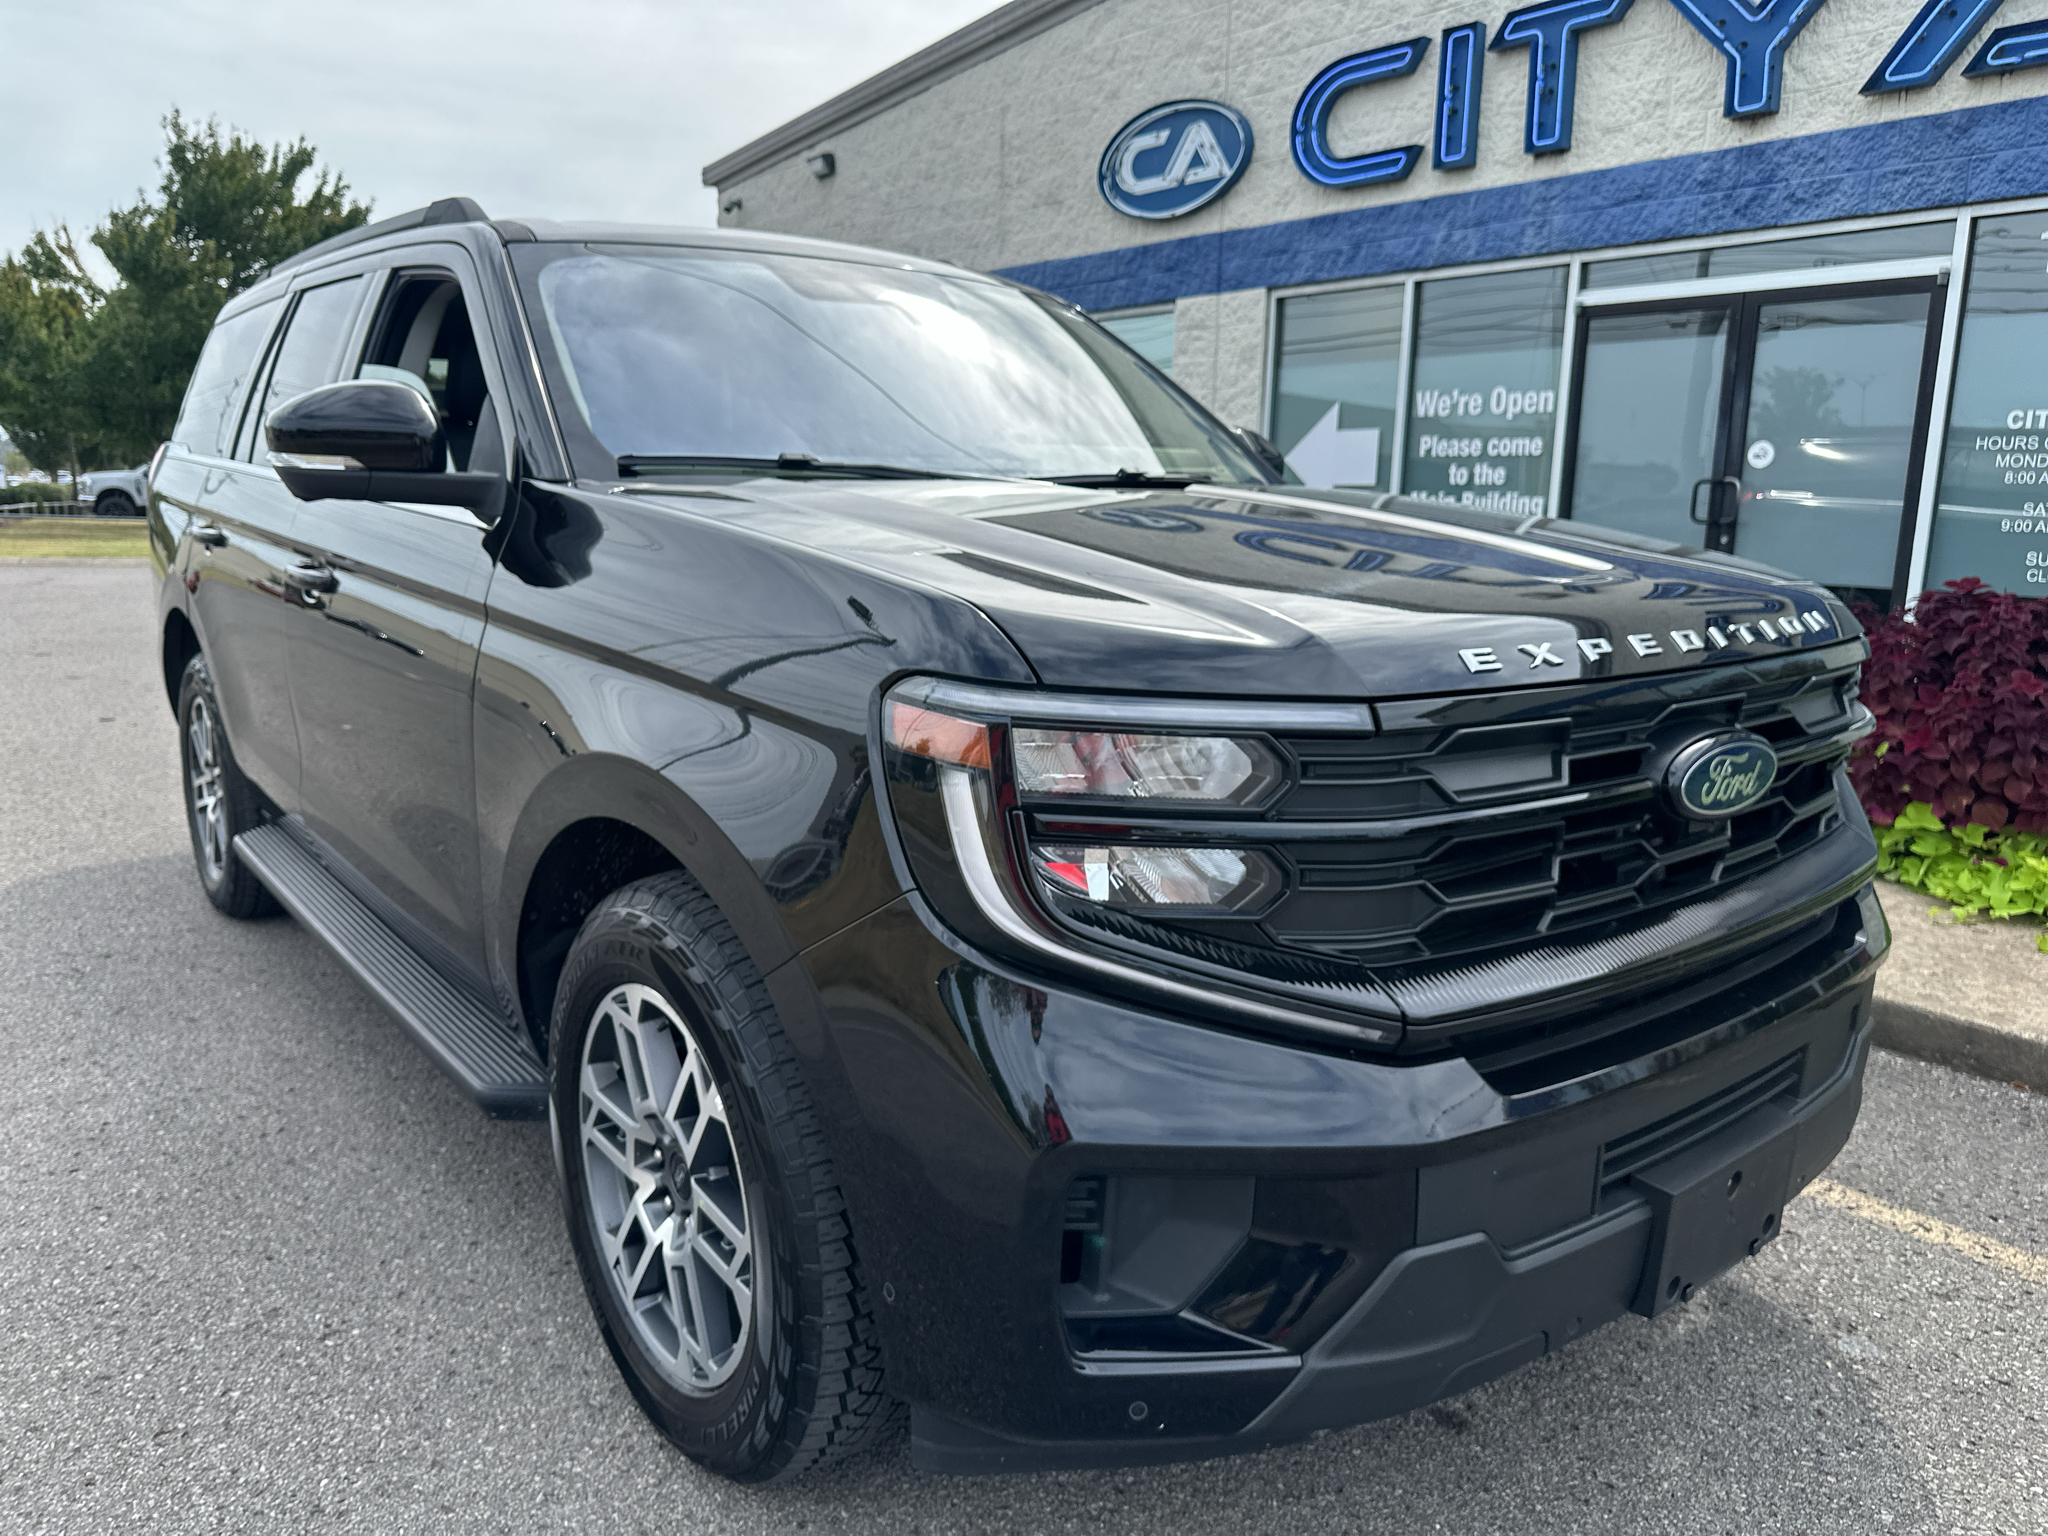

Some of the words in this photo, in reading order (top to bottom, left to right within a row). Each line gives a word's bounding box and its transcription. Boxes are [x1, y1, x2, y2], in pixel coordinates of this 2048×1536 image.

[1290, 0, 1822, 188] CITY
[1115, 119, 1232, 196] CA
[1416, 388, 1483, 418] We're
[1489, 385, 1555, 420] Open
[1419, 434, 1483, 458] Please
[1487, 435, 1543, 457] come
[1976, 435, 2039, 451] HOURS
[1995, 453, 2048, 468] MOND
[1448, 462, 1469, 486] to
[1473, 462, 1507, 486] the
[2004, 470, 2036, 485] 8:00
[2022, 501, 2048, 517] SA
[2001, 518, 2032, 533] 9:00
[2027, 568, 2048, 583] CL
[1458, 610, 1830, 674] EXPEDITION
[1701, 752, 1759, 806] Ford
[701, 1365, 760, 1444] PIRELLI
